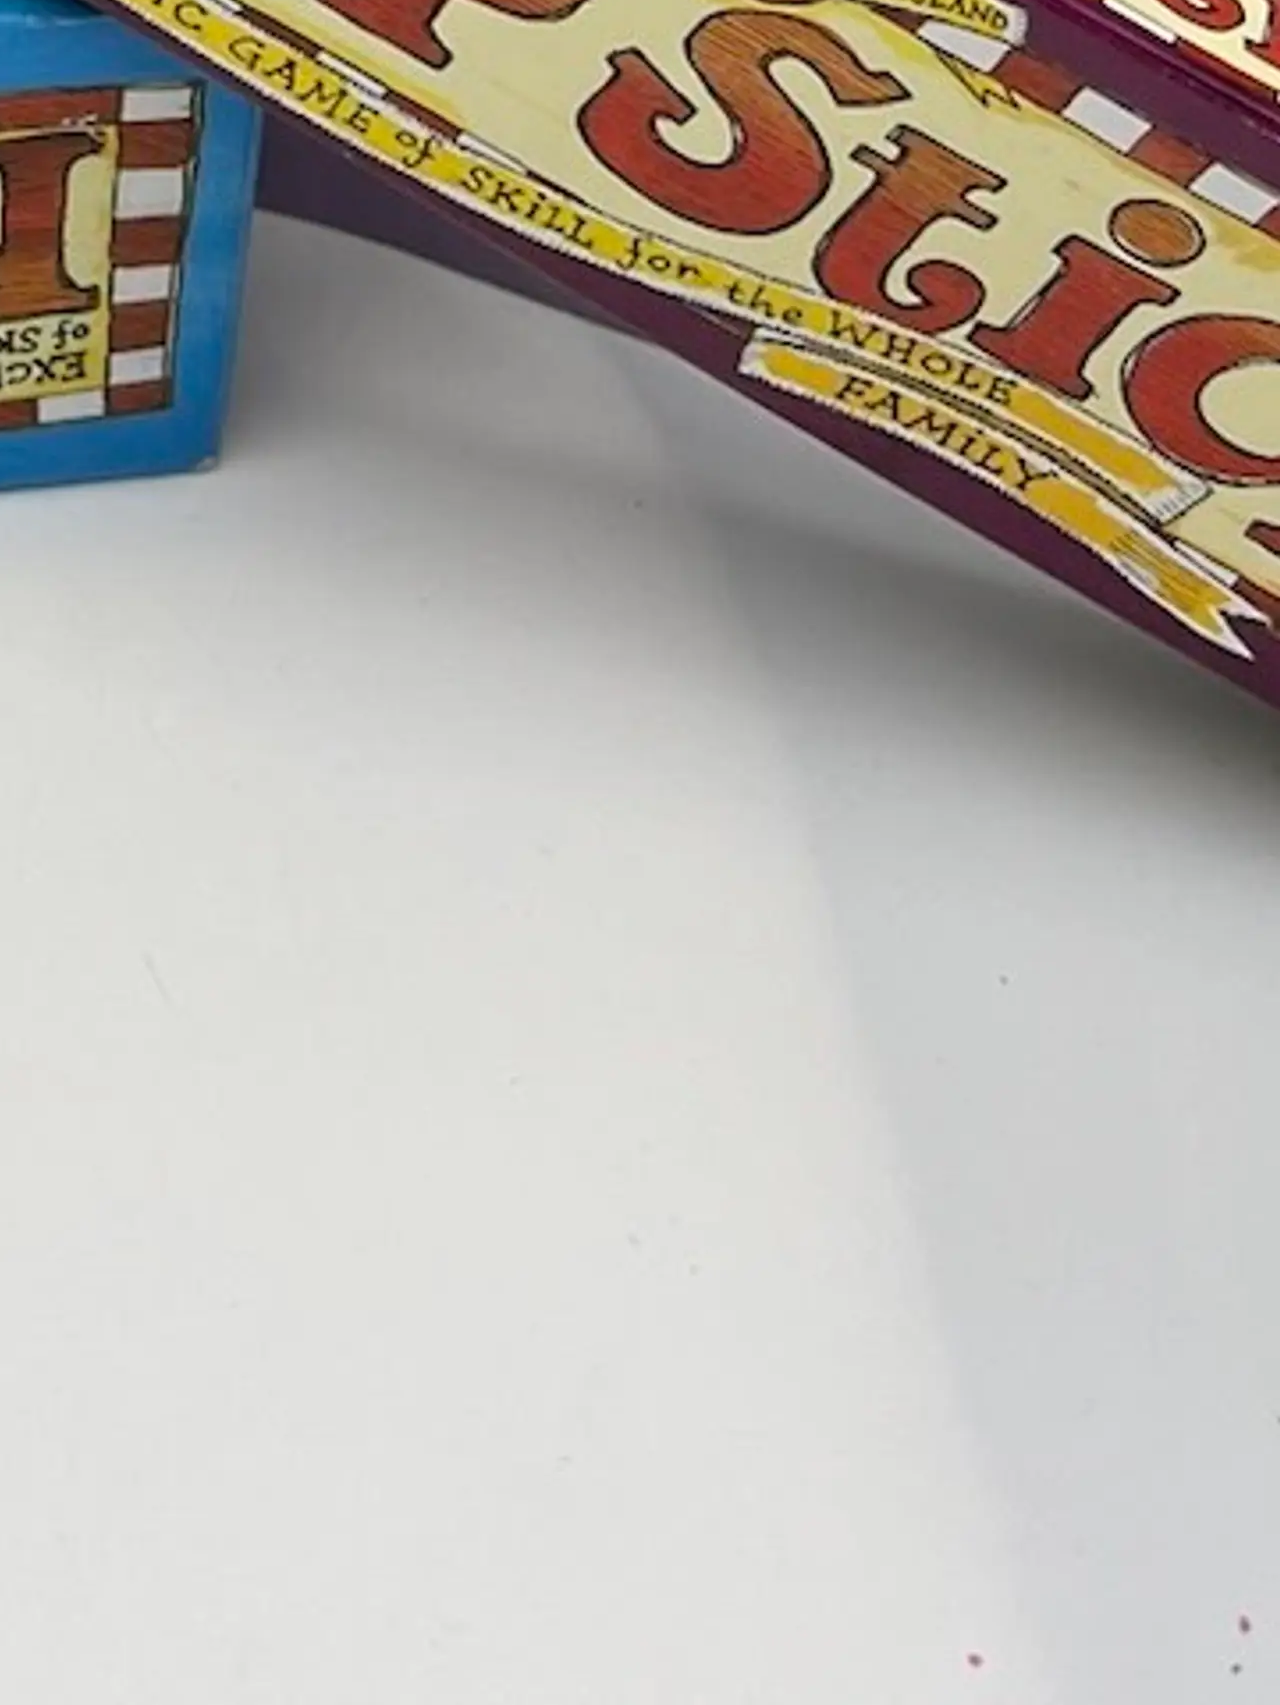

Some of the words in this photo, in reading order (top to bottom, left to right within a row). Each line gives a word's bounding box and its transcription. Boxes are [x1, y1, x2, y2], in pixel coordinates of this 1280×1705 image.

[227, 34, 374, 139] GAME
[395, 131, 438, 169] of
[614, 238, 705, 284] for
[727, 278, 806, 325] the
[830, 308, 1020, 409] WHOLE
[50, 321, 91, 348] of
